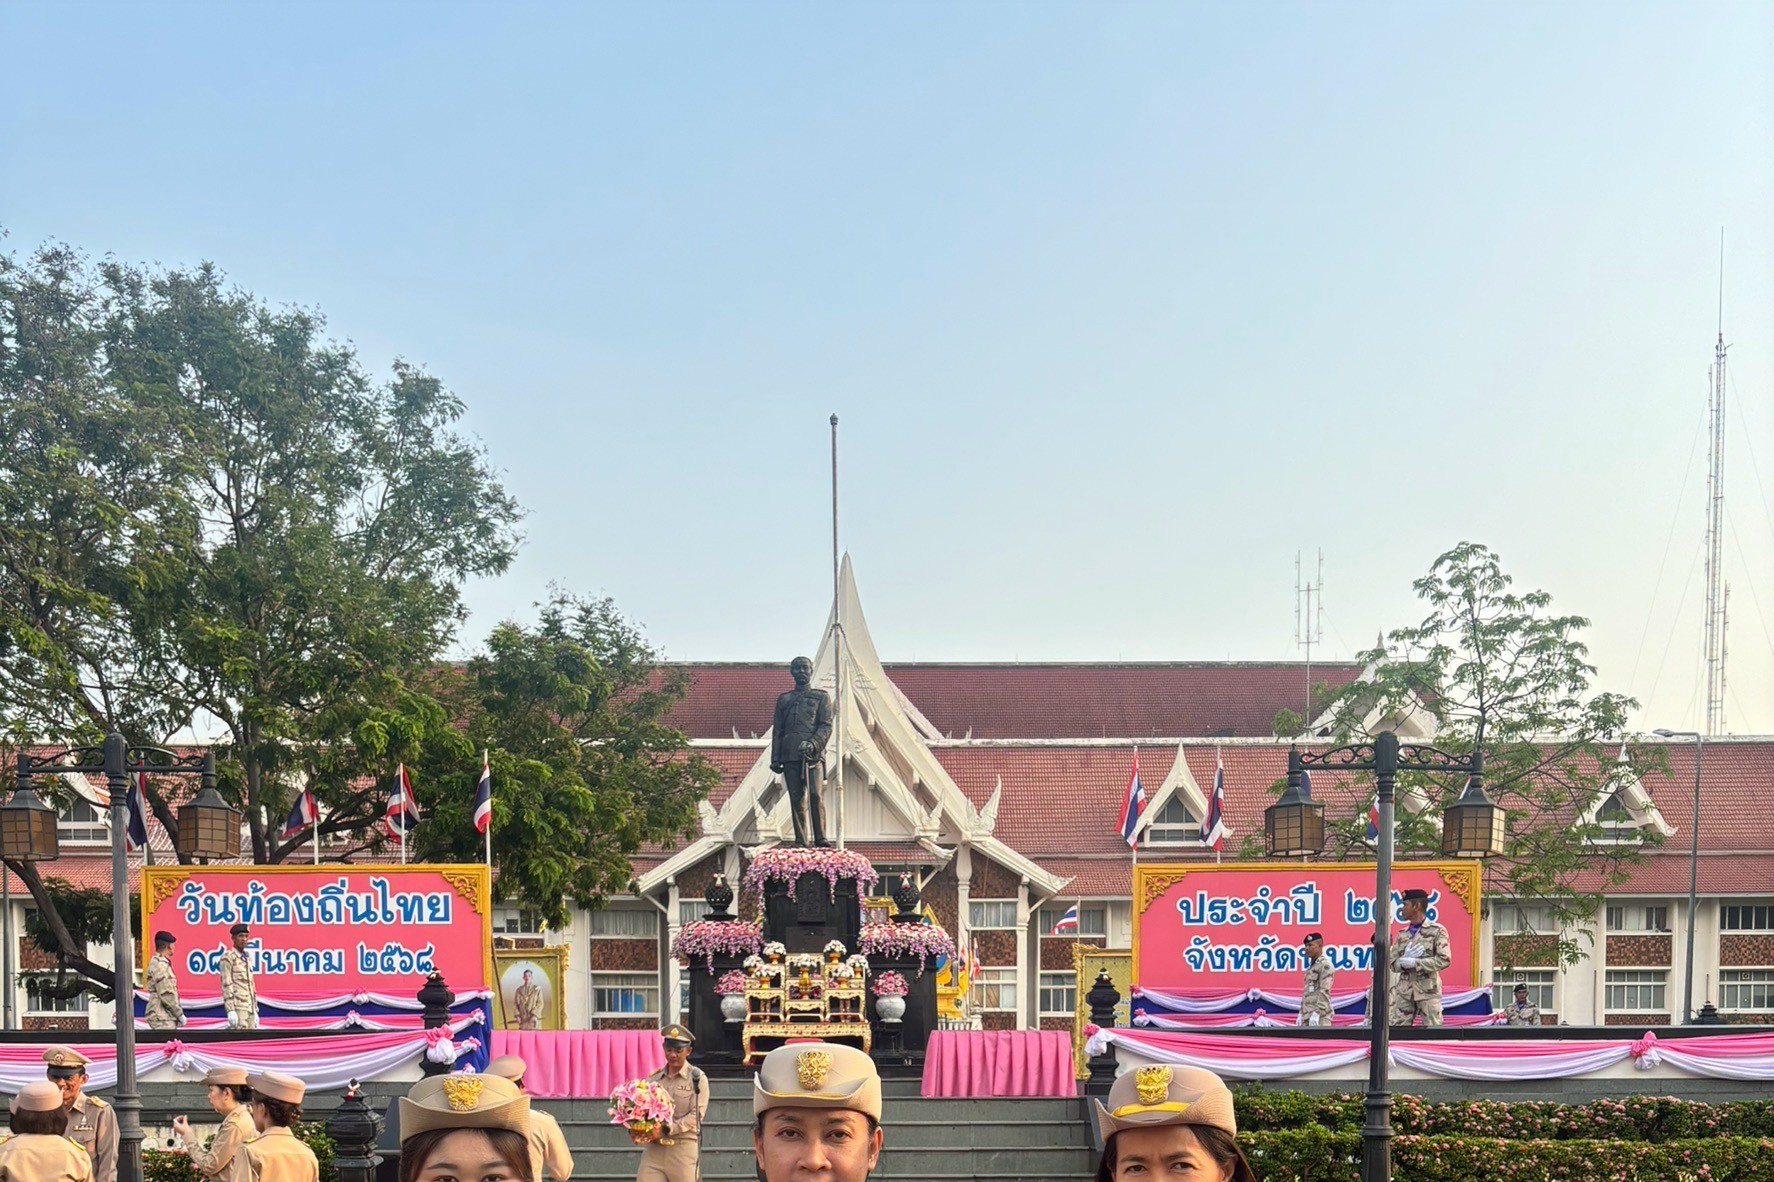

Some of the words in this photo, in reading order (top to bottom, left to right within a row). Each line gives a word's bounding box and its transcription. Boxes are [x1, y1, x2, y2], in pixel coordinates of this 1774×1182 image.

[178, 878, 451, 923] วันท้องถิ่นไทย
[1178, 883, 1320, 923] ประจำปี
[358, 943, 434, 973] ๒๕๖๘
